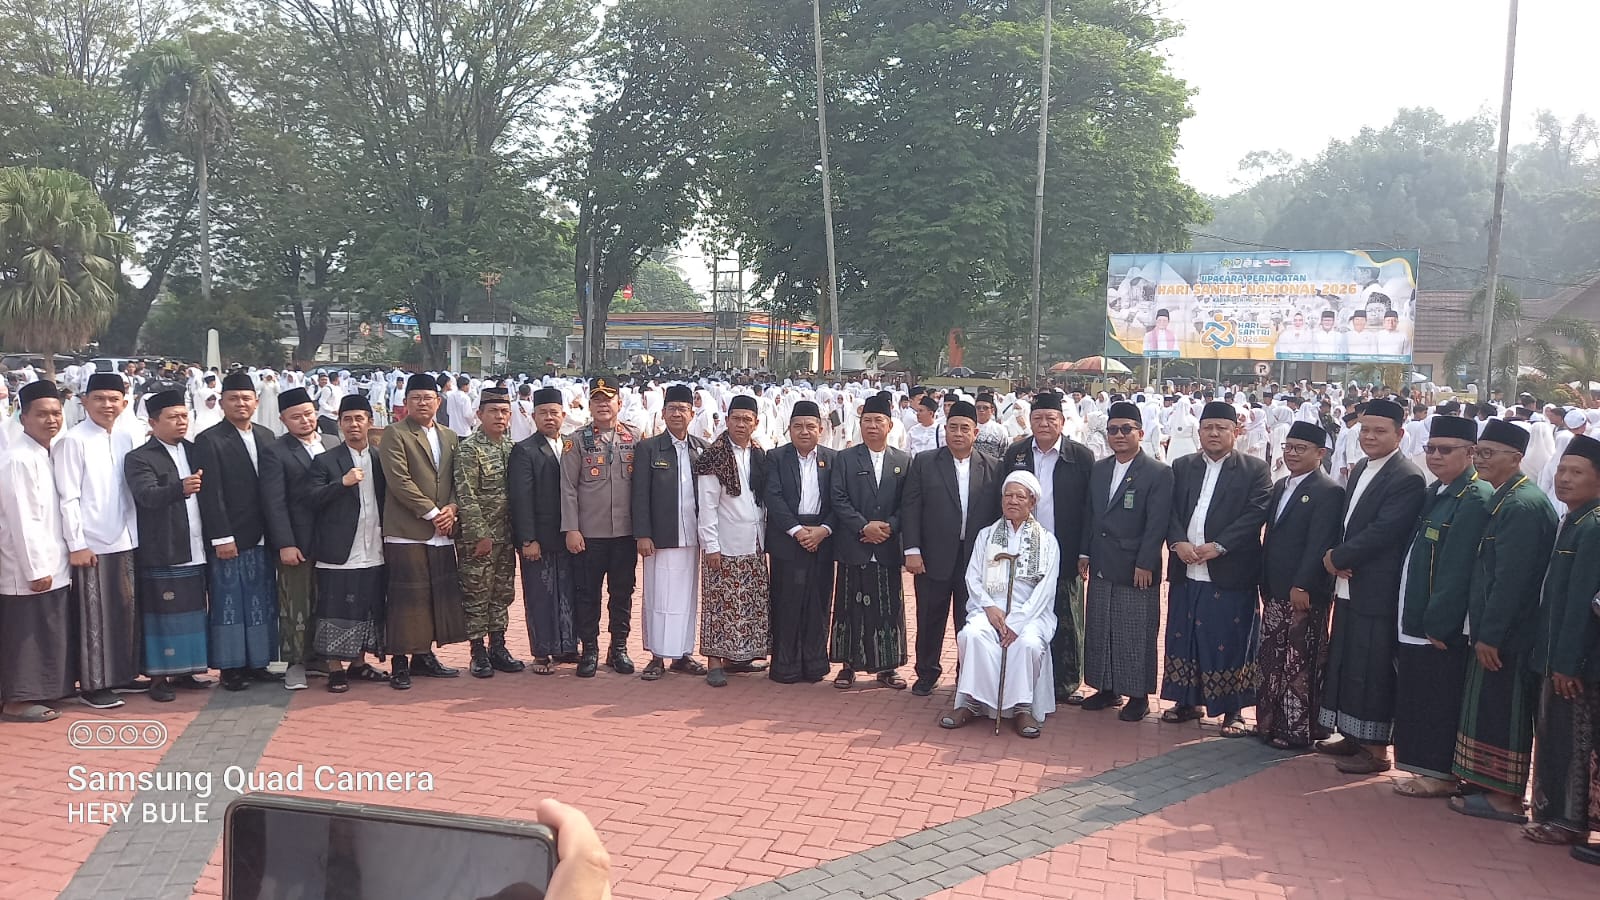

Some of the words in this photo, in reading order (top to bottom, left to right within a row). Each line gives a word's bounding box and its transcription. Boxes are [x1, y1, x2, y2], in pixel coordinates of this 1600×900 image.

[1201, 275, 1244, 283] UPACARA
[1247, 274, 1307, 282] PERINGATAN
[1157, 285, 1189, 295] HARI
[1193, 284, 1242, 295] SANTRI
[1246, 284, 1316, 295] NASIONAL
[1322, 283, 1357, 294] 2026
